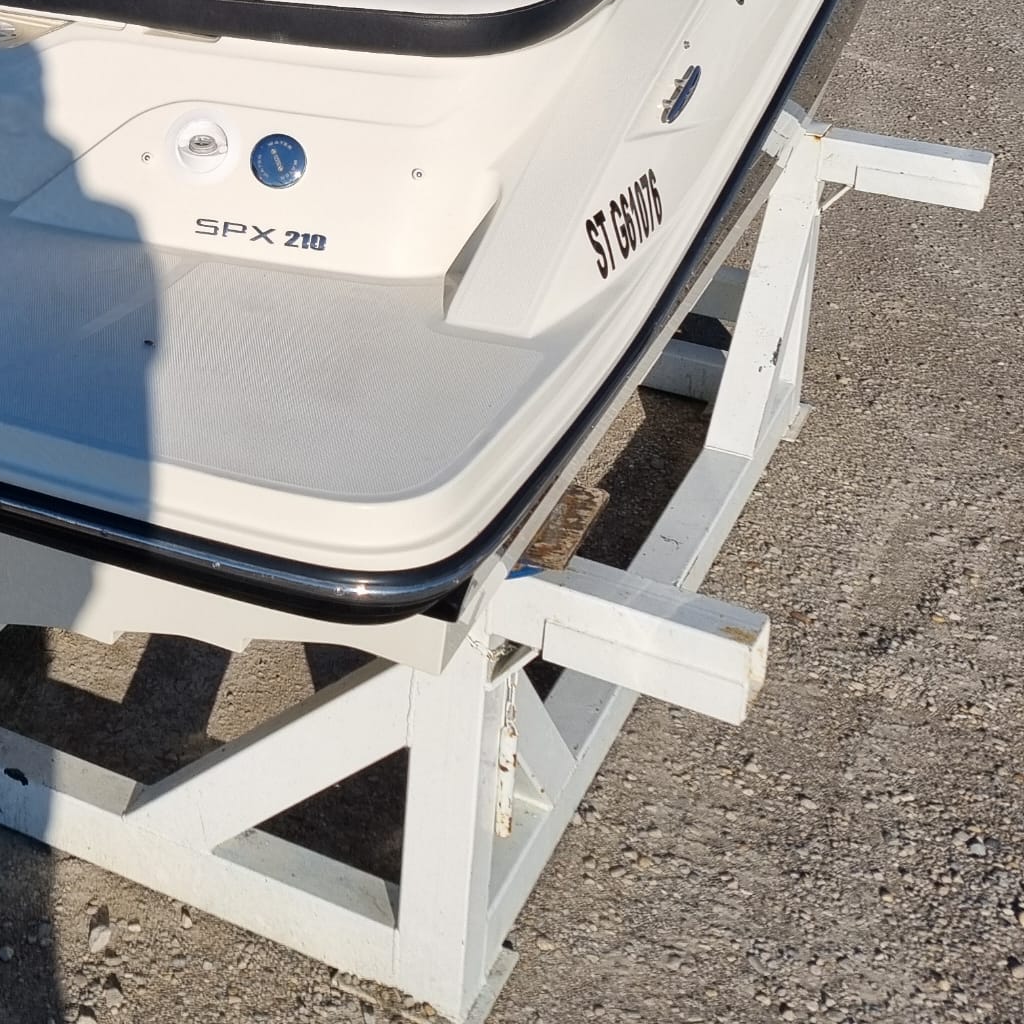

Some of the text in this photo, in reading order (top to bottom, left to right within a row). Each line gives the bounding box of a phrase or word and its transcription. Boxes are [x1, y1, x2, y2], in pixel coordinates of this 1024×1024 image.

[194, 218, 327, 251] SPX 210
[585, 168, 663, 279] ST G61076
